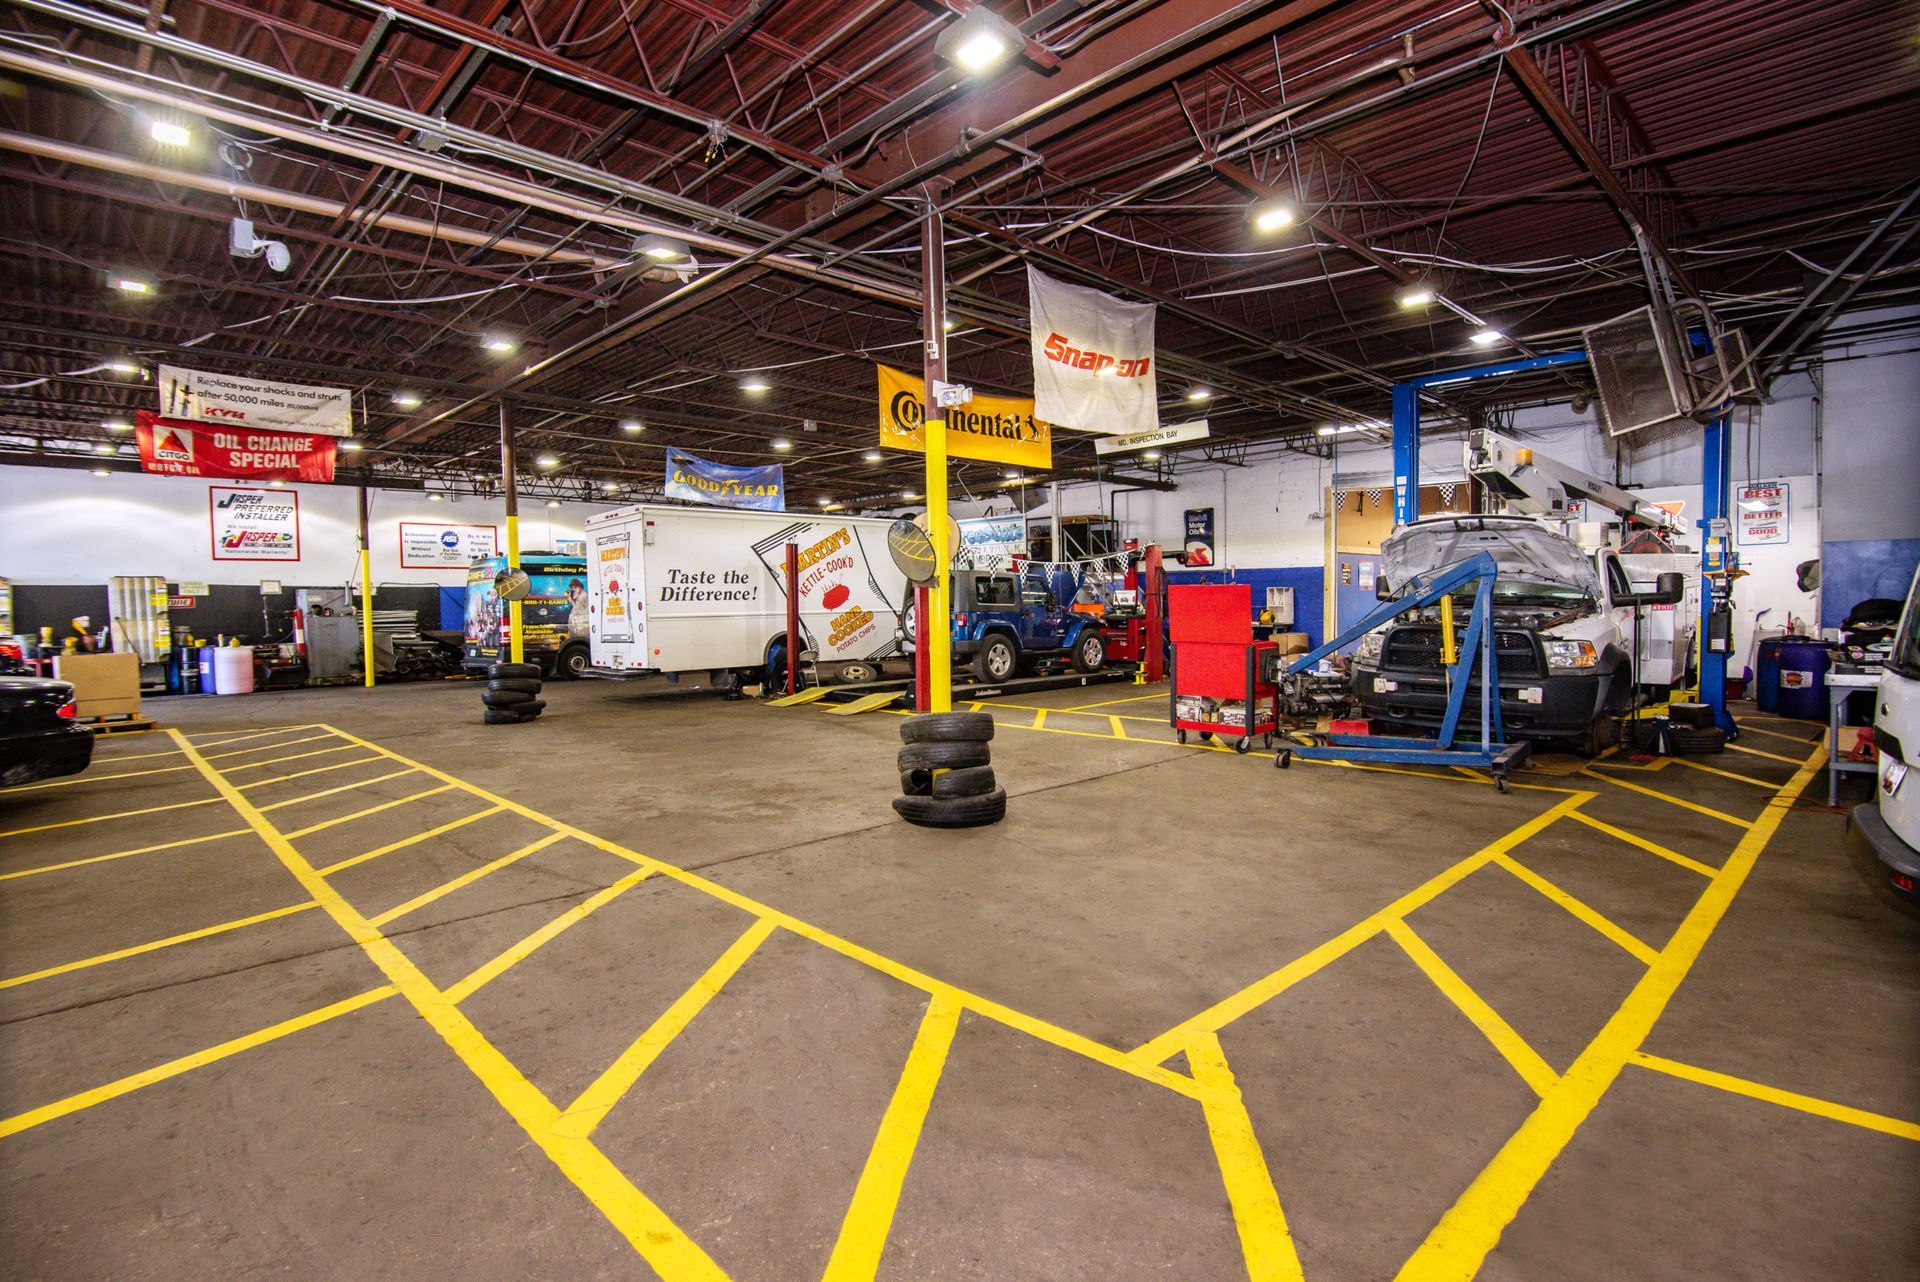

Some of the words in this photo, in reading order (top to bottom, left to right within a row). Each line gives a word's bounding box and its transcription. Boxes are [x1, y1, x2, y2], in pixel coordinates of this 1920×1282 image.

[1044, 332, 1150, 378] Snap-on
[197, 376, 237, 390] Replace
[238, 383, 262, 393] your
[263, 385, 295, 397] shocks
[297, 388, 315, 399] and
[317, 391, 342, 401] struts
[197, 390, 222, 400] after
[223, 393, 258, 405] 50,000
[260, 398, 285, 408] miles
[891, 390, 1022, 440] Coinental
[213, 432, 242, 450] OIL
[247, 435, 313, 452] CHANGE
[1130, 433, 1164, 445] INSPECTION
[1166, 430, 1178, 439] BAY
[158, 451, 190, 461] CITGO
[229, 451, 301, 468] SPECIAL
[147, 462, 183, 473] MOTOR
[186, 465, 201, 474] OIL
[673, 470, 780, 497] GOODYEAR
[217, 493, 264, 509] JASPER
[1744, 488, 1782, 499] BEST
[233, 504, 294, 514] PREFERRED
[233, 512, 289, 521] INSTALLER
[1744, 511, 1782, 520] BETTER
[224, 530, 278, 548] JASPER
[667, 569, 716, 584] Taste
[723, 569, 750, 584] the
[659, 586, 758, 602] Difference!
[830, 605, 862, 632] HAND
[828, 610, 874, 647] COOKED
[836, 636, 858, 653] POTATO
[858, 624, 876, 638] CHIPS
